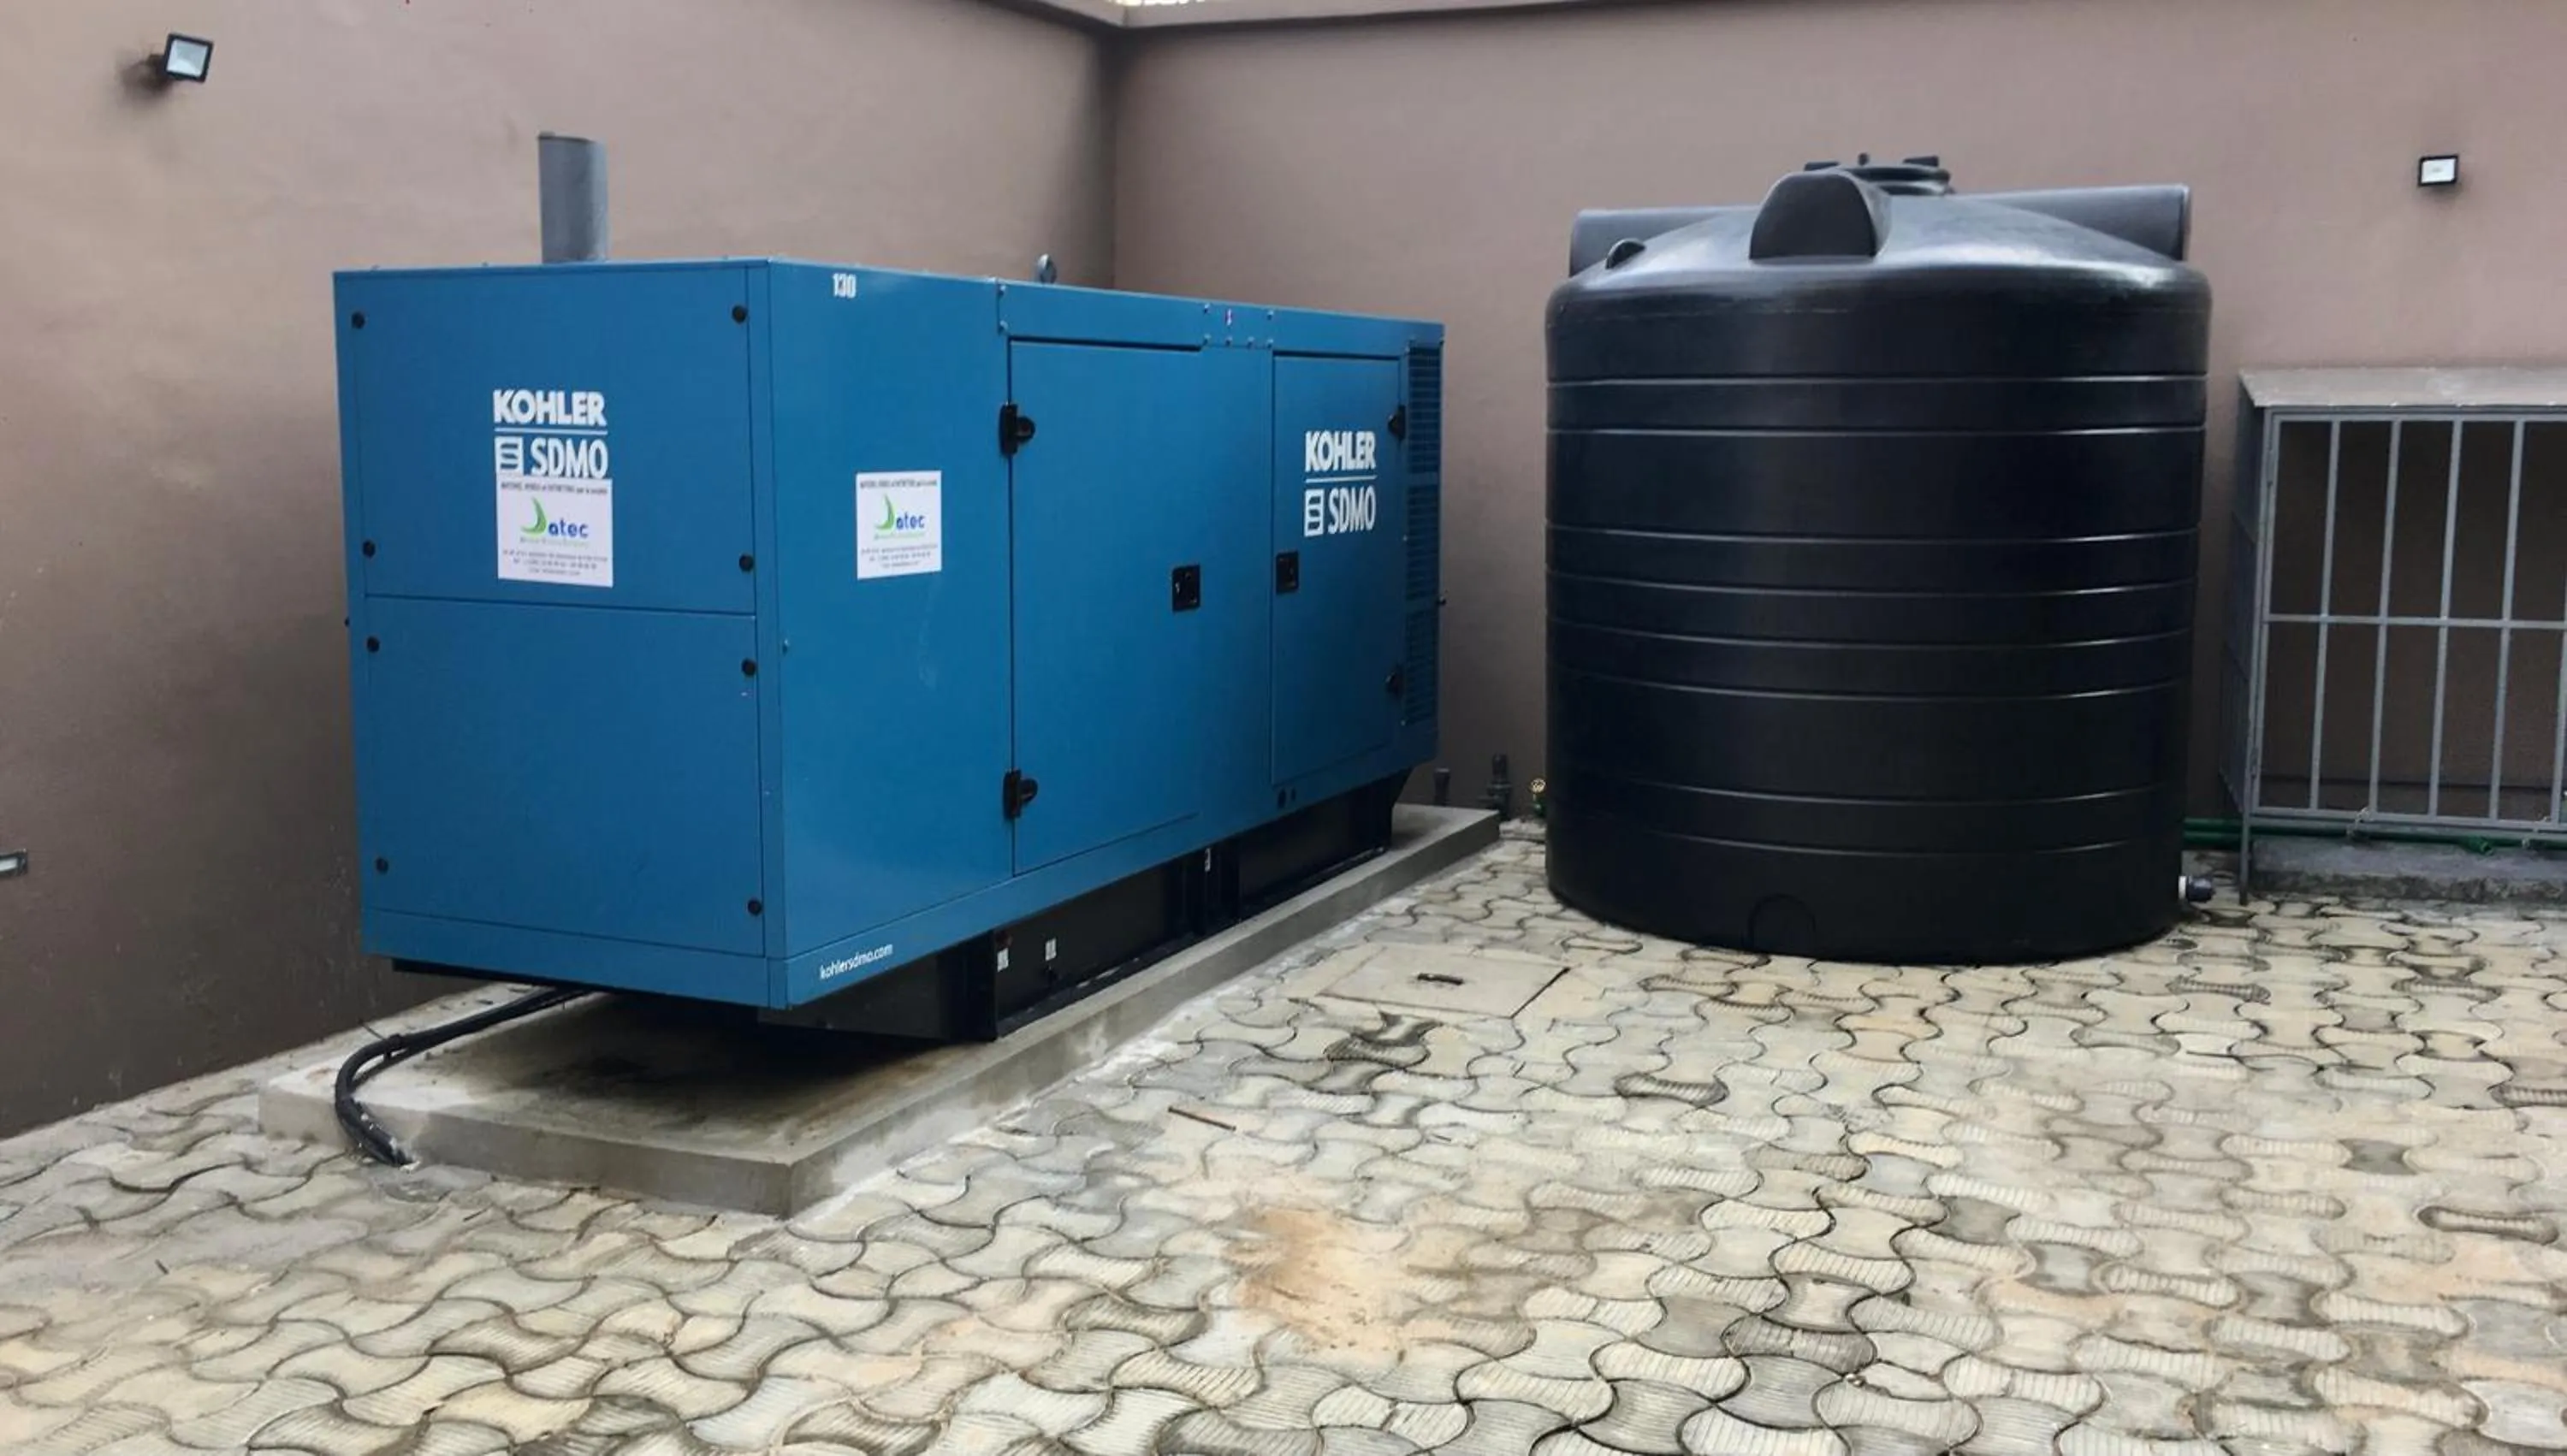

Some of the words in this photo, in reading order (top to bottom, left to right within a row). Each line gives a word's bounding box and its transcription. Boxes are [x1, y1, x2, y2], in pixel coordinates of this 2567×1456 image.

[833, 273, 857, 299] 130
[493, 389, 608, 427] KOHLER
[530, 437, 608, 479] SDMO
[1305, 430, 1377, 472] KOHLER
[1327, 485, 1377, 535] SDMO
[820, 944, 893, 980] kohlersdmo.com
